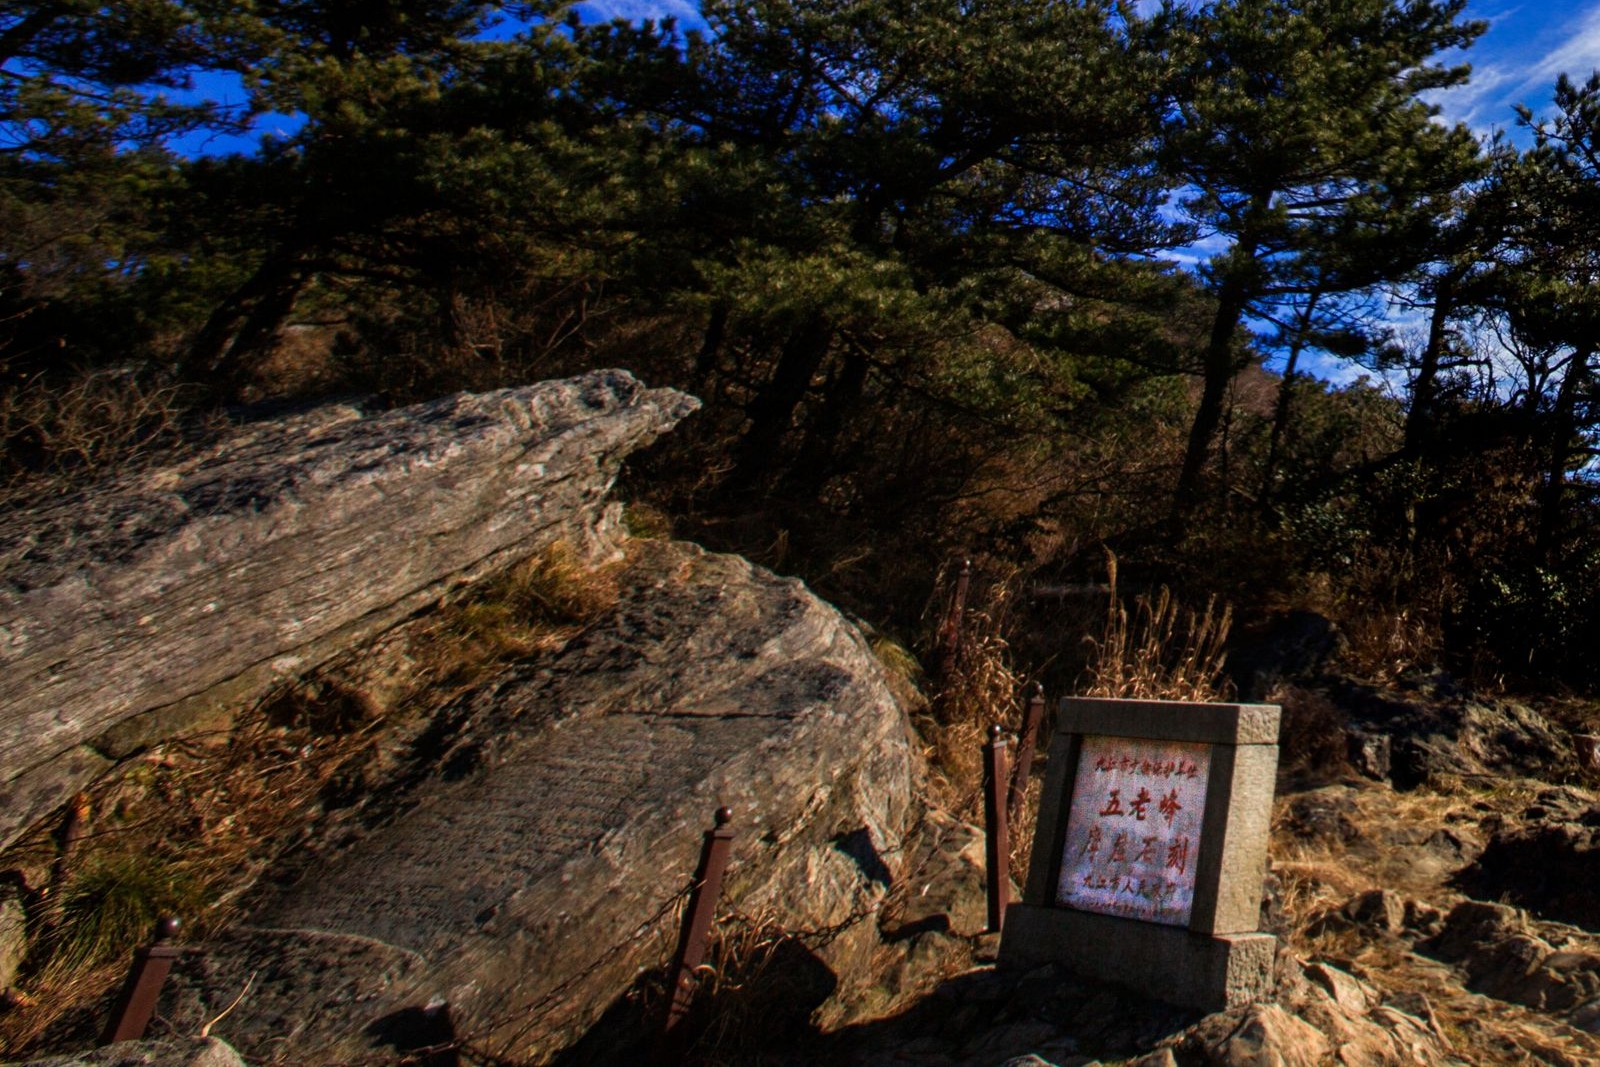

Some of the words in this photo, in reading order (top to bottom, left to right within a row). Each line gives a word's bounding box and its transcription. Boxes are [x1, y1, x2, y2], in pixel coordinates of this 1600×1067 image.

[1099, 786, 1182, 828] 五老峰
[1078, 823, 1189, 874] 摩崖石刻
